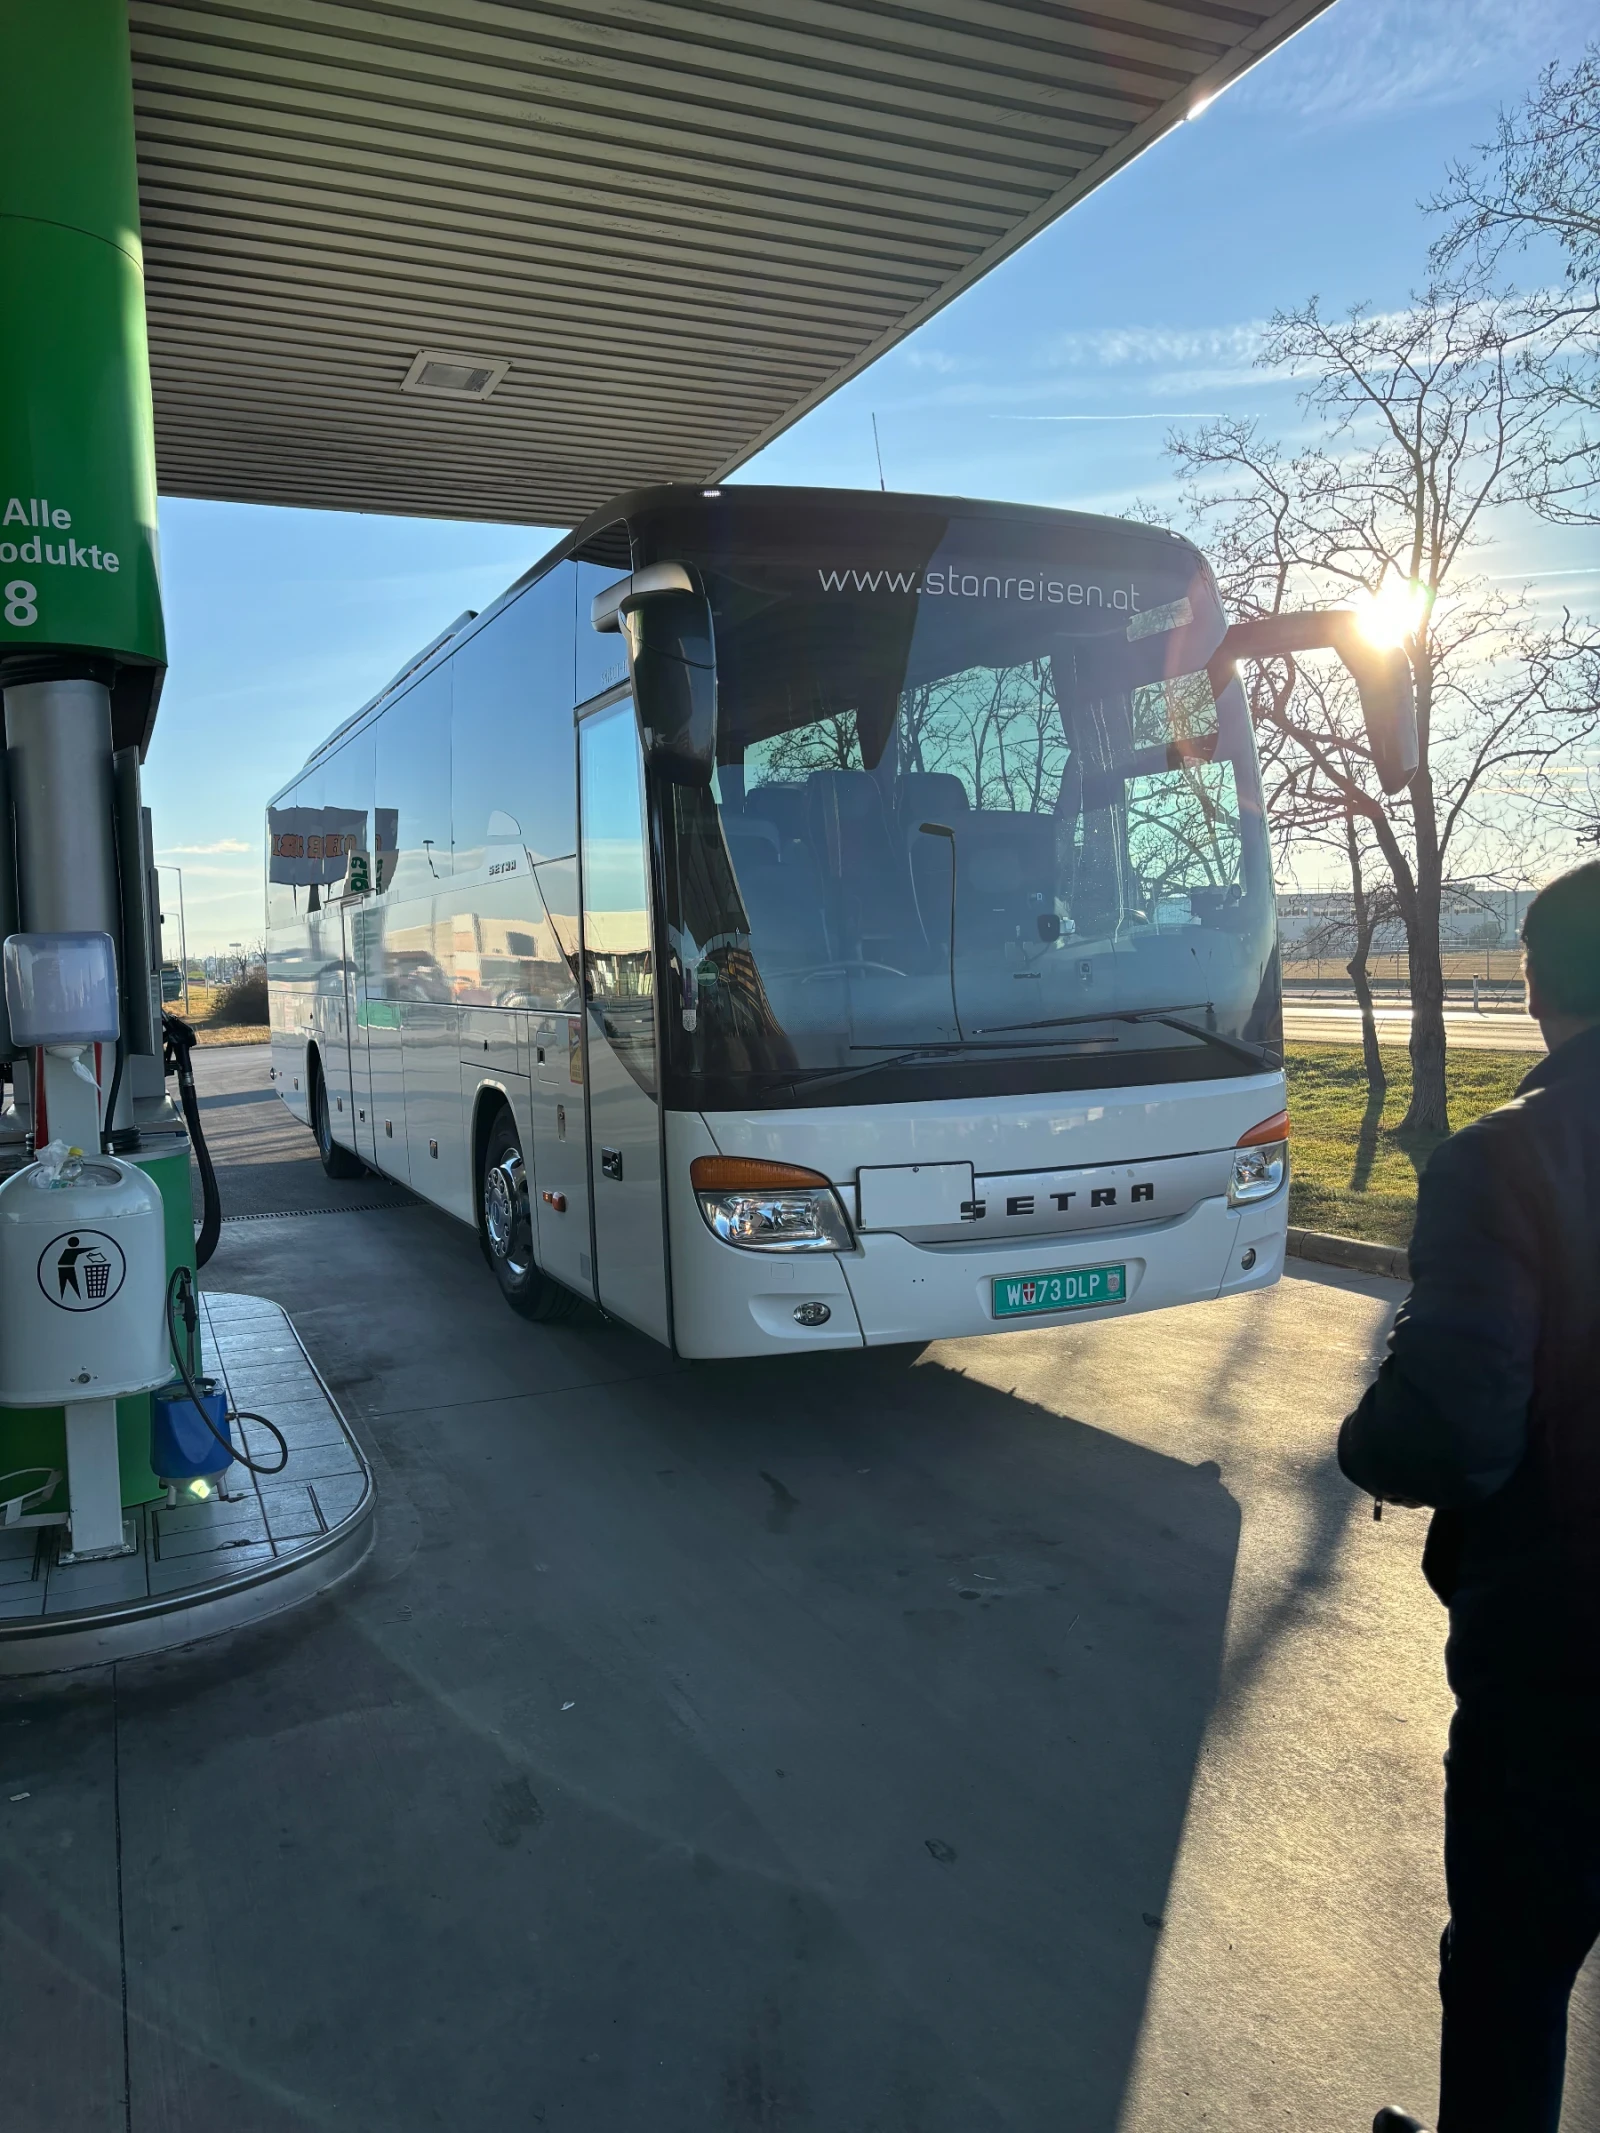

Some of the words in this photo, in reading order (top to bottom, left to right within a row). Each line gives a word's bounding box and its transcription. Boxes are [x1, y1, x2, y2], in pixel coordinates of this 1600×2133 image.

[2, 498, 72, 530] Alle
[4, 580, 38, 627] 8
[818, 565, 1140, 612] www.stanreisen.at
[960, 1183, 1154, 1221] SETRA
[1006, 1283, 1021, 1307] W
